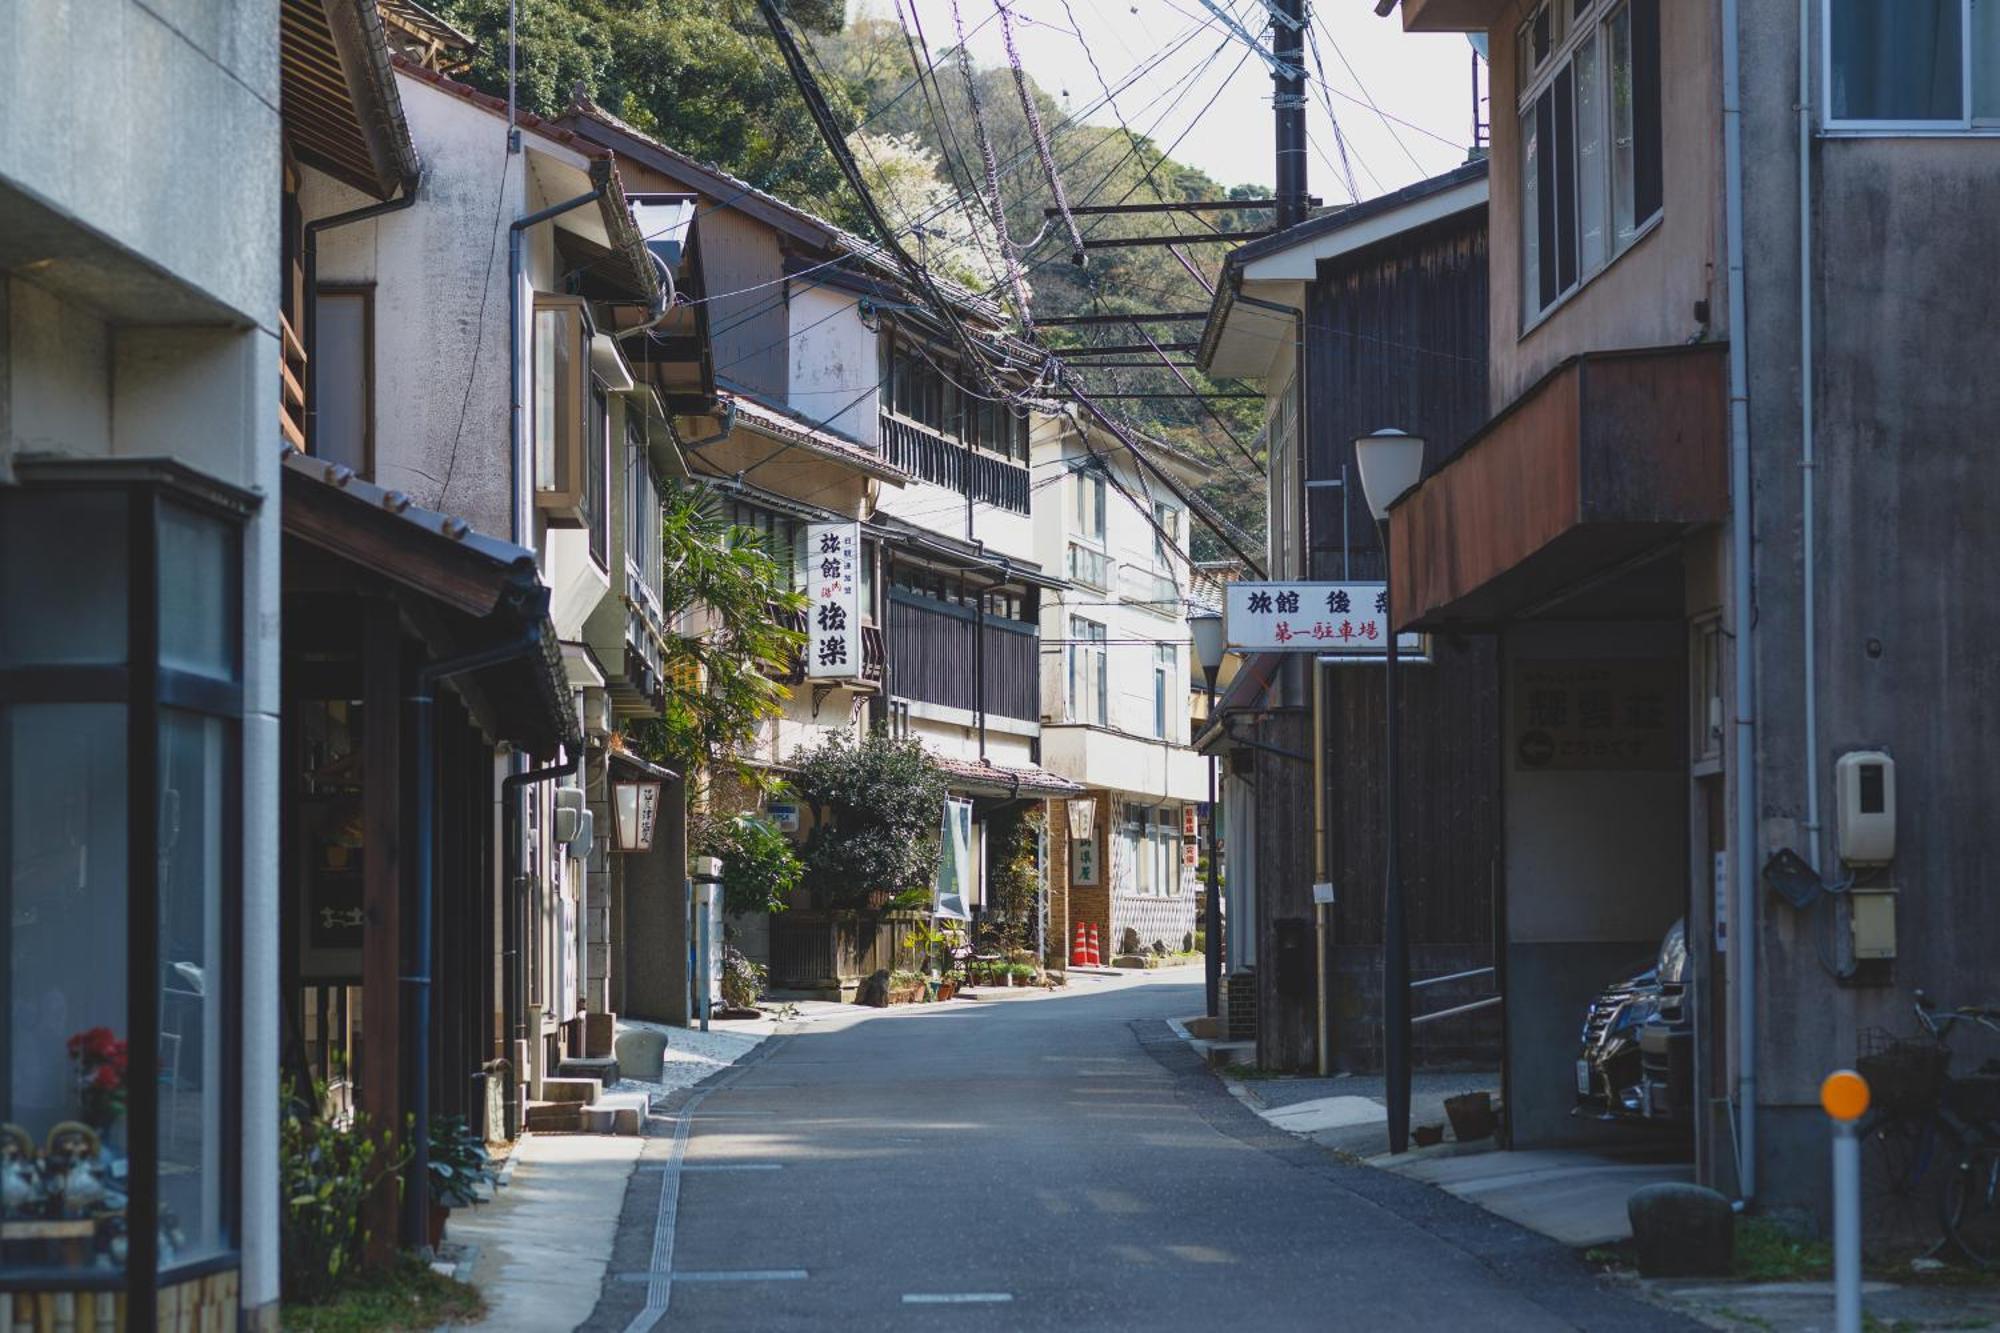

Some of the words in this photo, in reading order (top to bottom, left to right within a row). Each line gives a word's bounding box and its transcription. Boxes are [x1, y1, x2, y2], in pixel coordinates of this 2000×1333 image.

[820, 533, 841, 578] 旅館
[1247, 589, 1300, 614] 旅館
[817, 602, 847, 666] 後楽
[1275, 619, 1379, 643] 第一駐車場
